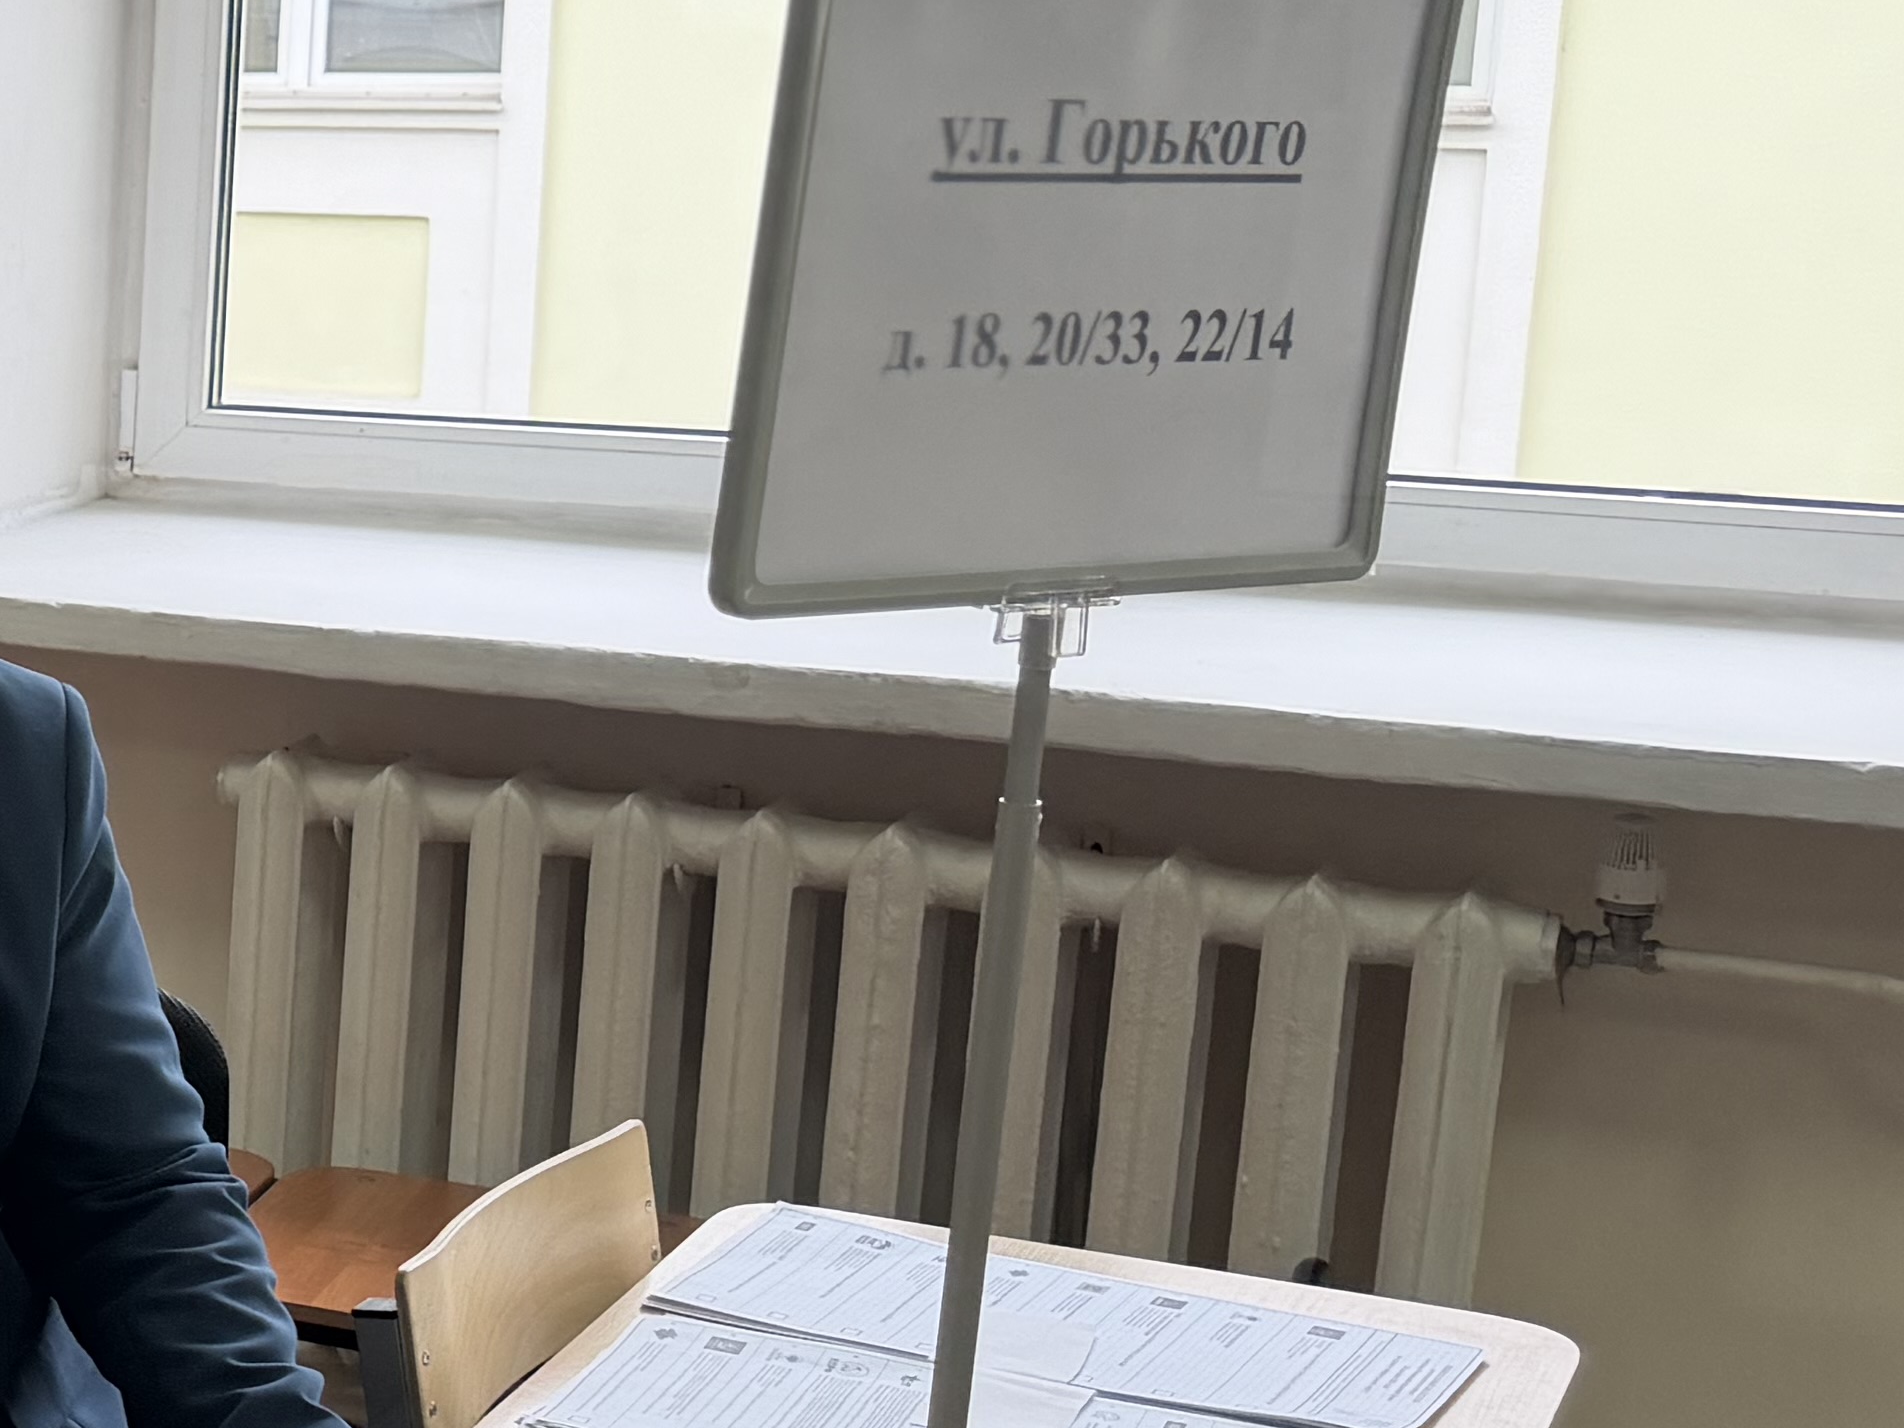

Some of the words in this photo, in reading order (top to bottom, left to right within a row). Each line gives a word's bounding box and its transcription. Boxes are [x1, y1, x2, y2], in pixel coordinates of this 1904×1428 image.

[939, 114, 1020, 173] ул.
[1040, 97, 1308, 174] Горького
[882, 329, 926, 375] д.
[944, 312, 1010, 377] 18,
[1024, 307, 1160, 375] 20/33,
[1174, 306, 1296, 364] 22/14
